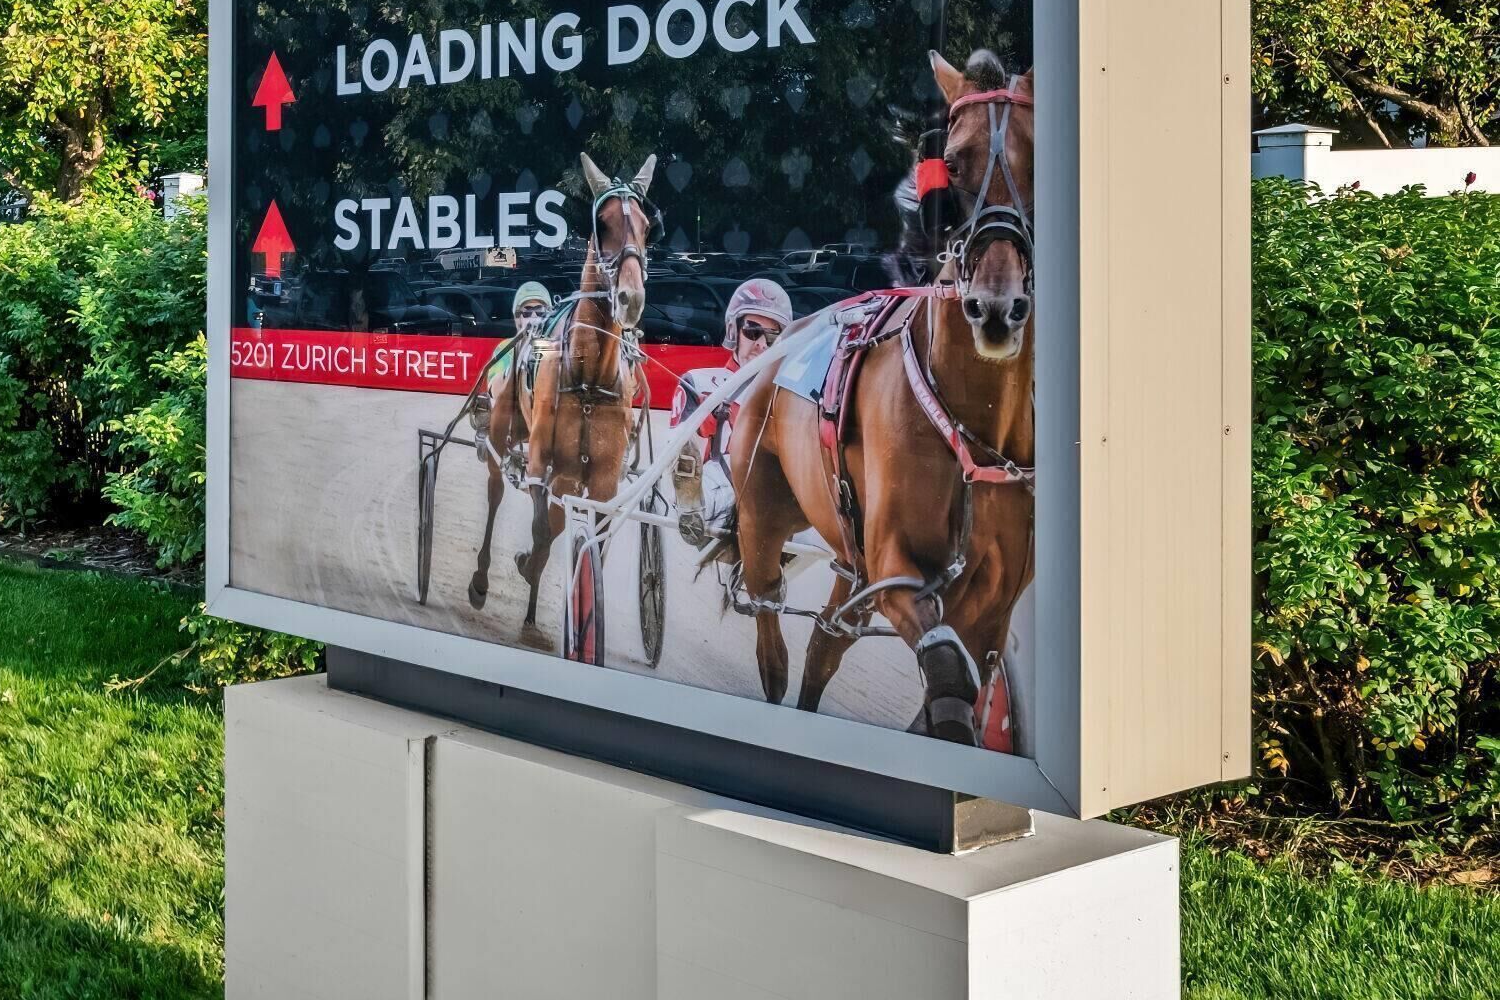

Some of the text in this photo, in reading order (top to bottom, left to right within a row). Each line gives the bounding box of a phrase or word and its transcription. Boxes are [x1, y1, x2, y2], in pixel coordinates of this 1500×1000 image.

[337, 12, 583, 96] LOADING
[333, 189, 568, 251] STABLES
[231, 341, 473, 380] 5201 ZURICH STREET
